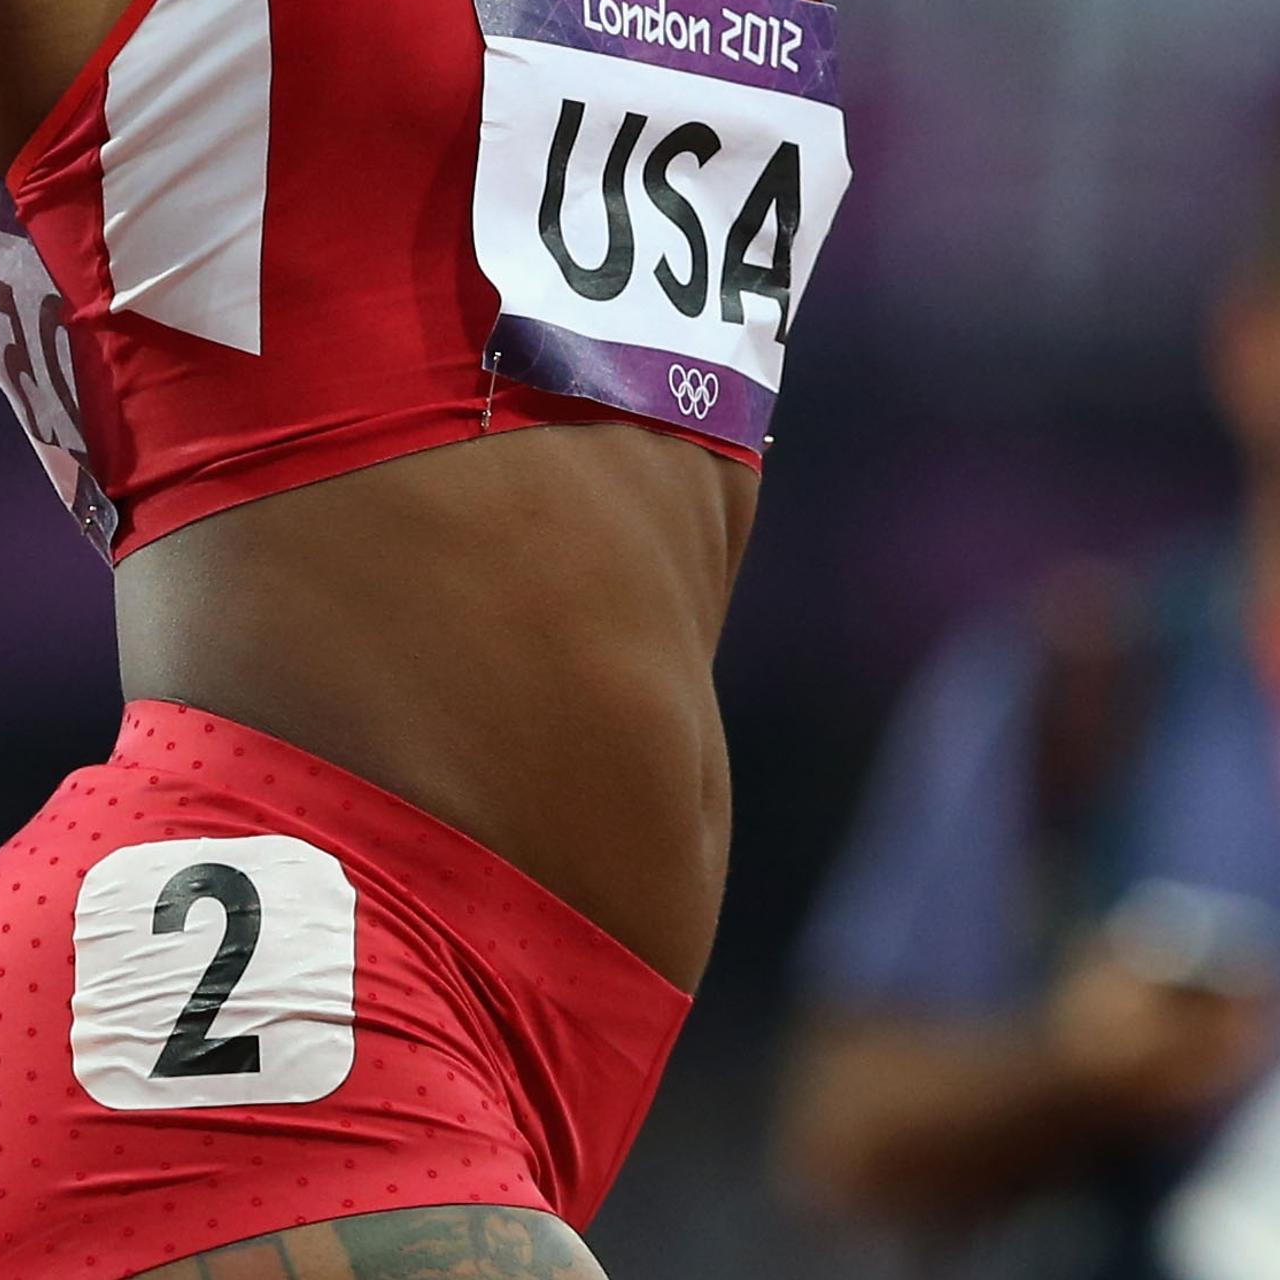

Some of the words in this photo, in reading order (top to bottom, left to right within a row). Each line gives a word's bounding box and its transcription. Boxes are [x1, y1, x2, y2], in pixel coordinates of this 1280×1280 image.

[719, 7, 804, 74] 2012
[538, 99, 801, 346] USA
[149, 862, 263, 1080] 2
